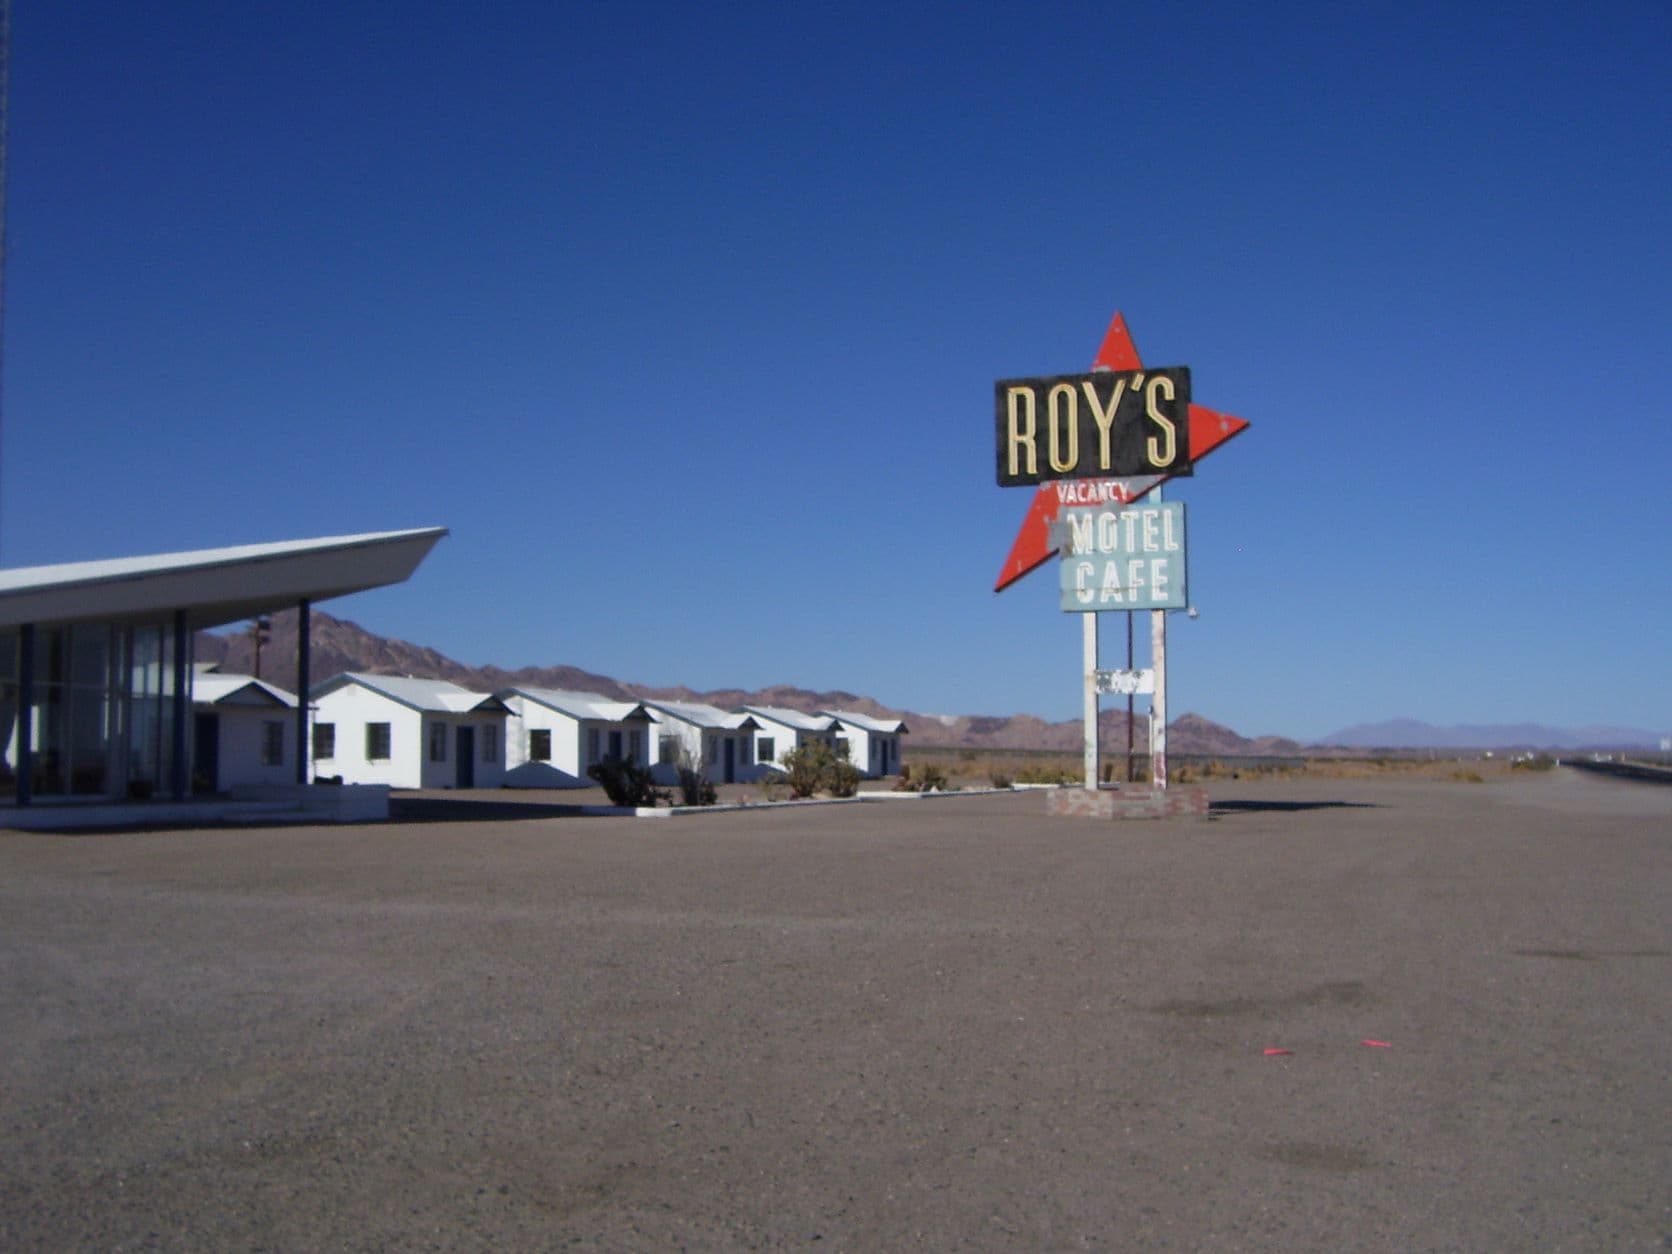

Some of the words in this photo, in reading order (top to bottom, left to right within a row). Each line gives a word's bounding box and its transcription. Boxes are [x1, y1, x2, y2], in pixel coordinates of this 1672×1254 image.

[1008, 373, 1176, 475] ROY'S
[1057, 482, 1130, 503] VACANCY
[1067, 509, 1178, 554] MOTEL
[1076, 558, 1169, 604] CAFE
